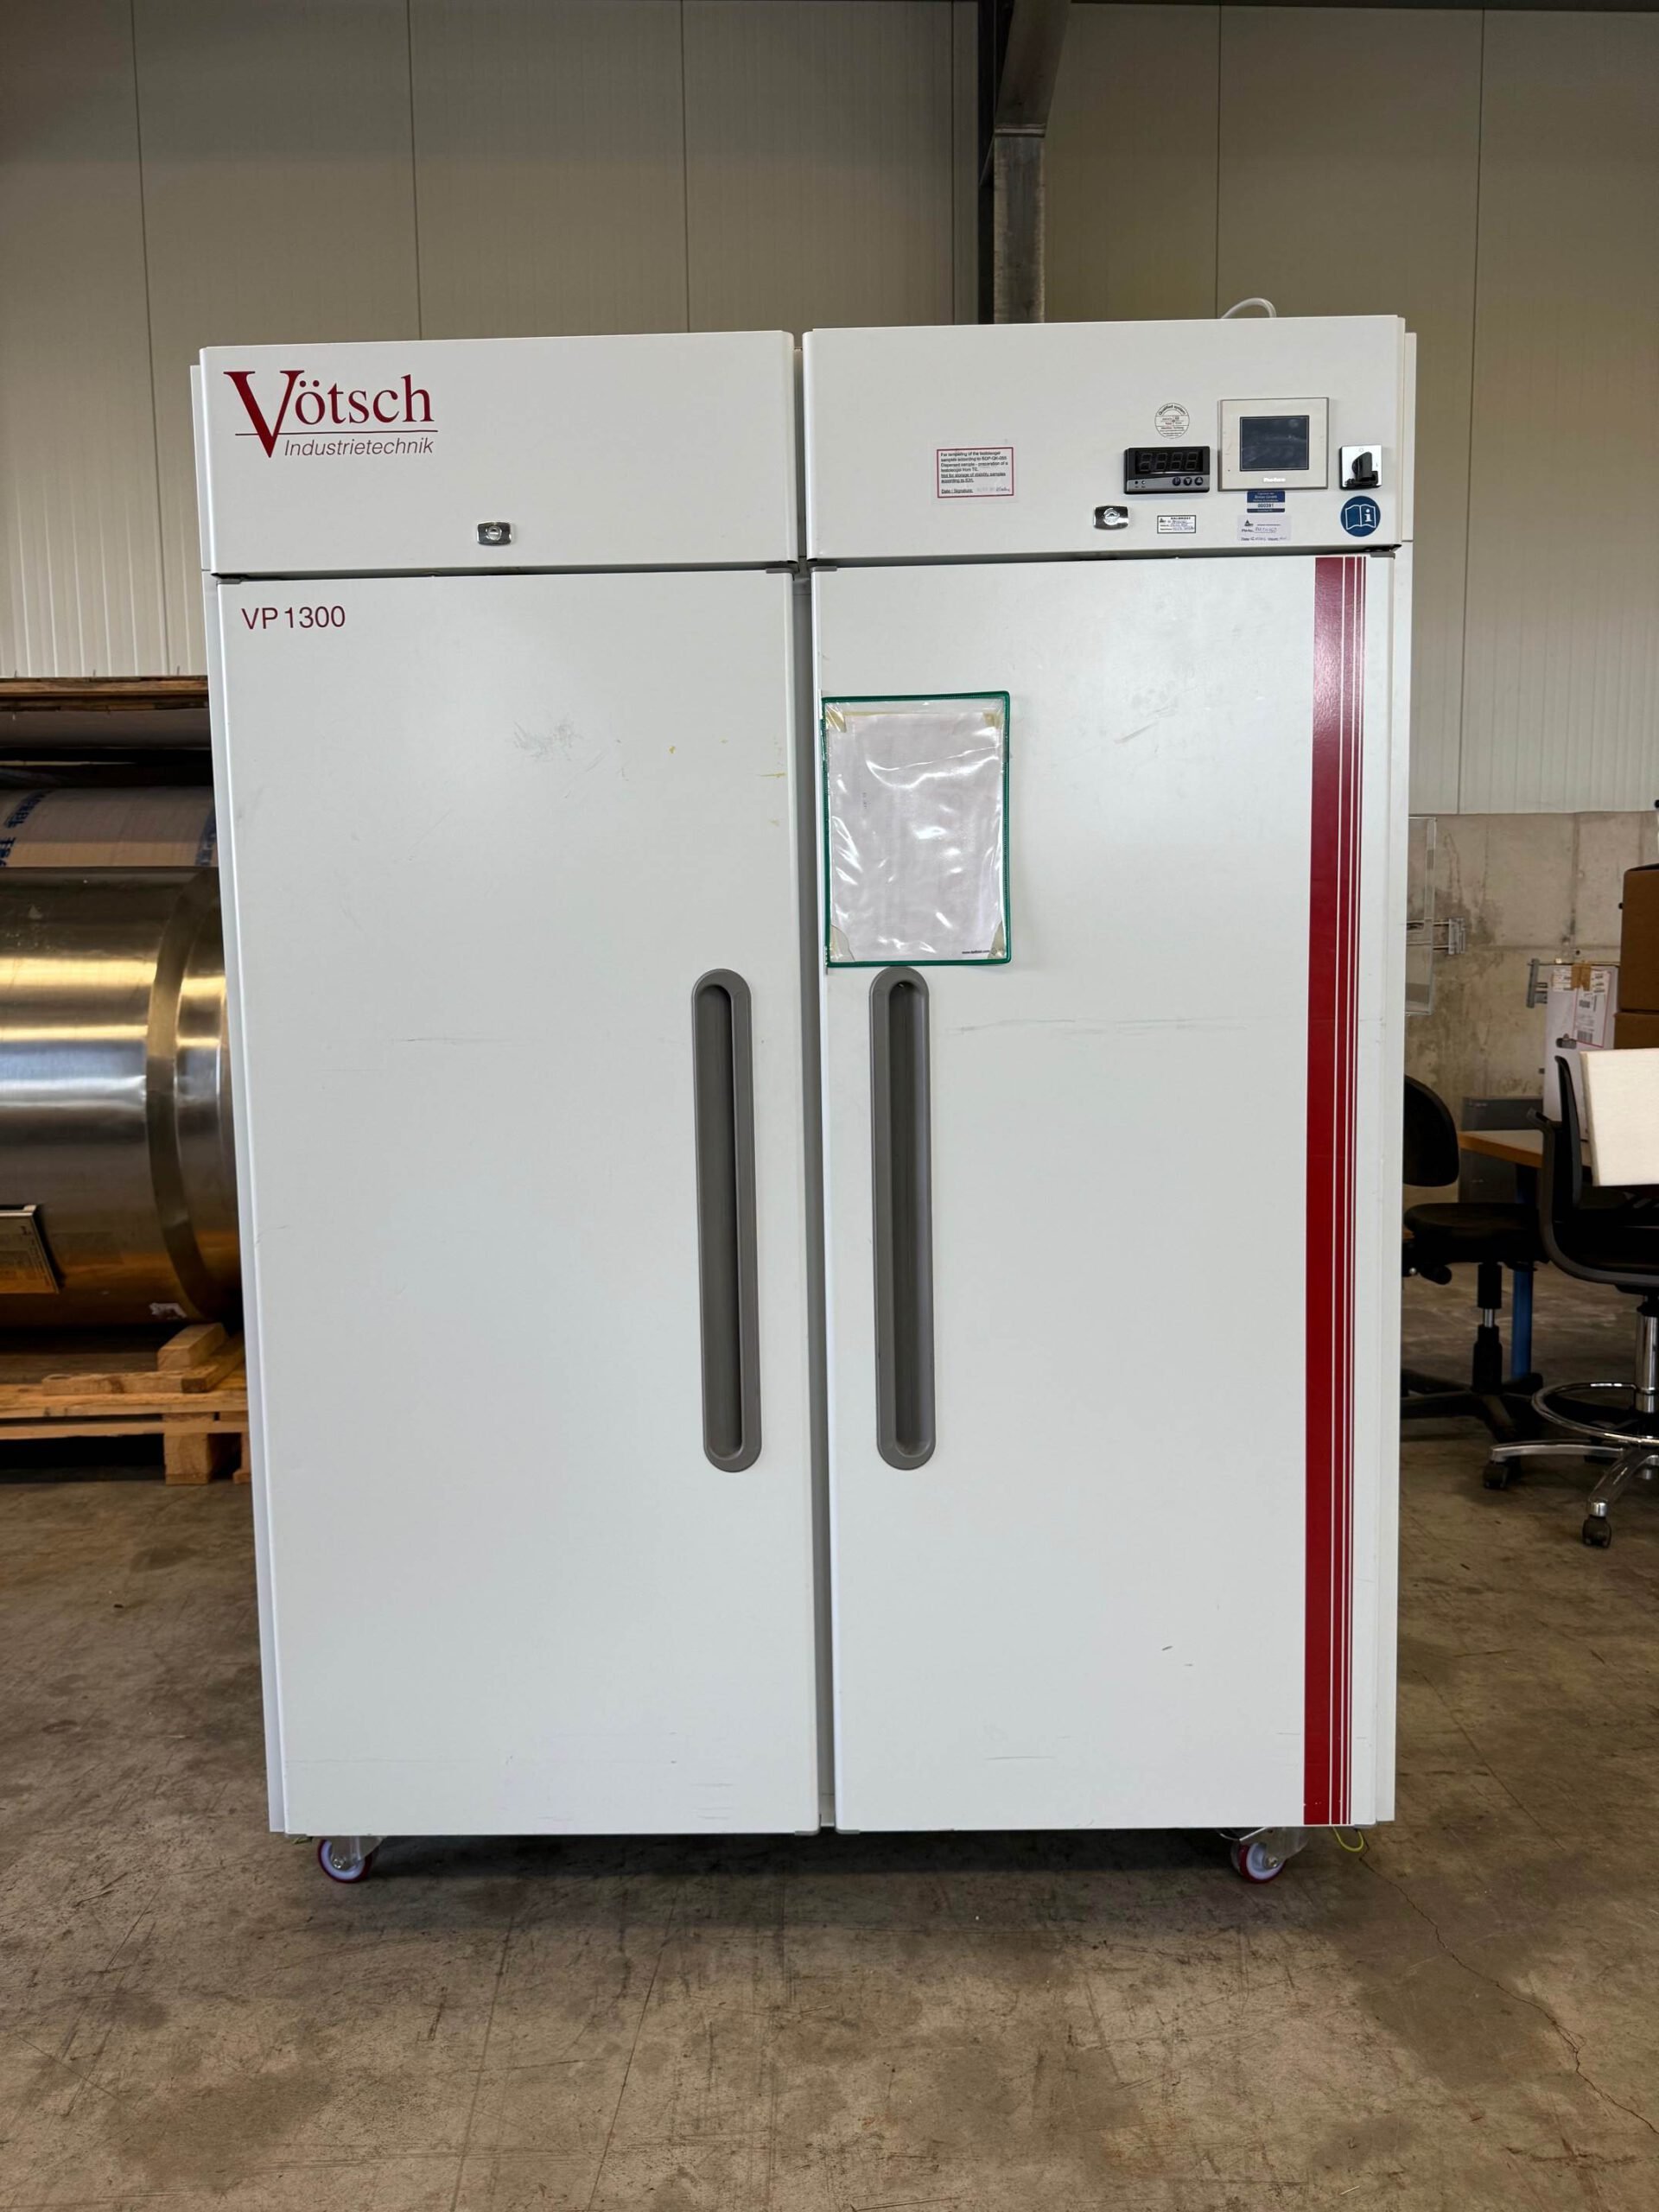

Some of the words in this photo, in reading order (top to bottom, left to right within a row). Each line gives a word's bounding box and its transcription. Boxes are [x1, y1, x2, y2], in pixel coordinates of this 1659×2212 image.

[223, 370, 435, 458] Vötsch
[283, 437, 435, 456] Industrietechnik
[241, 607, 278, 629] VP
[283, 606, 346, 629] 1300
